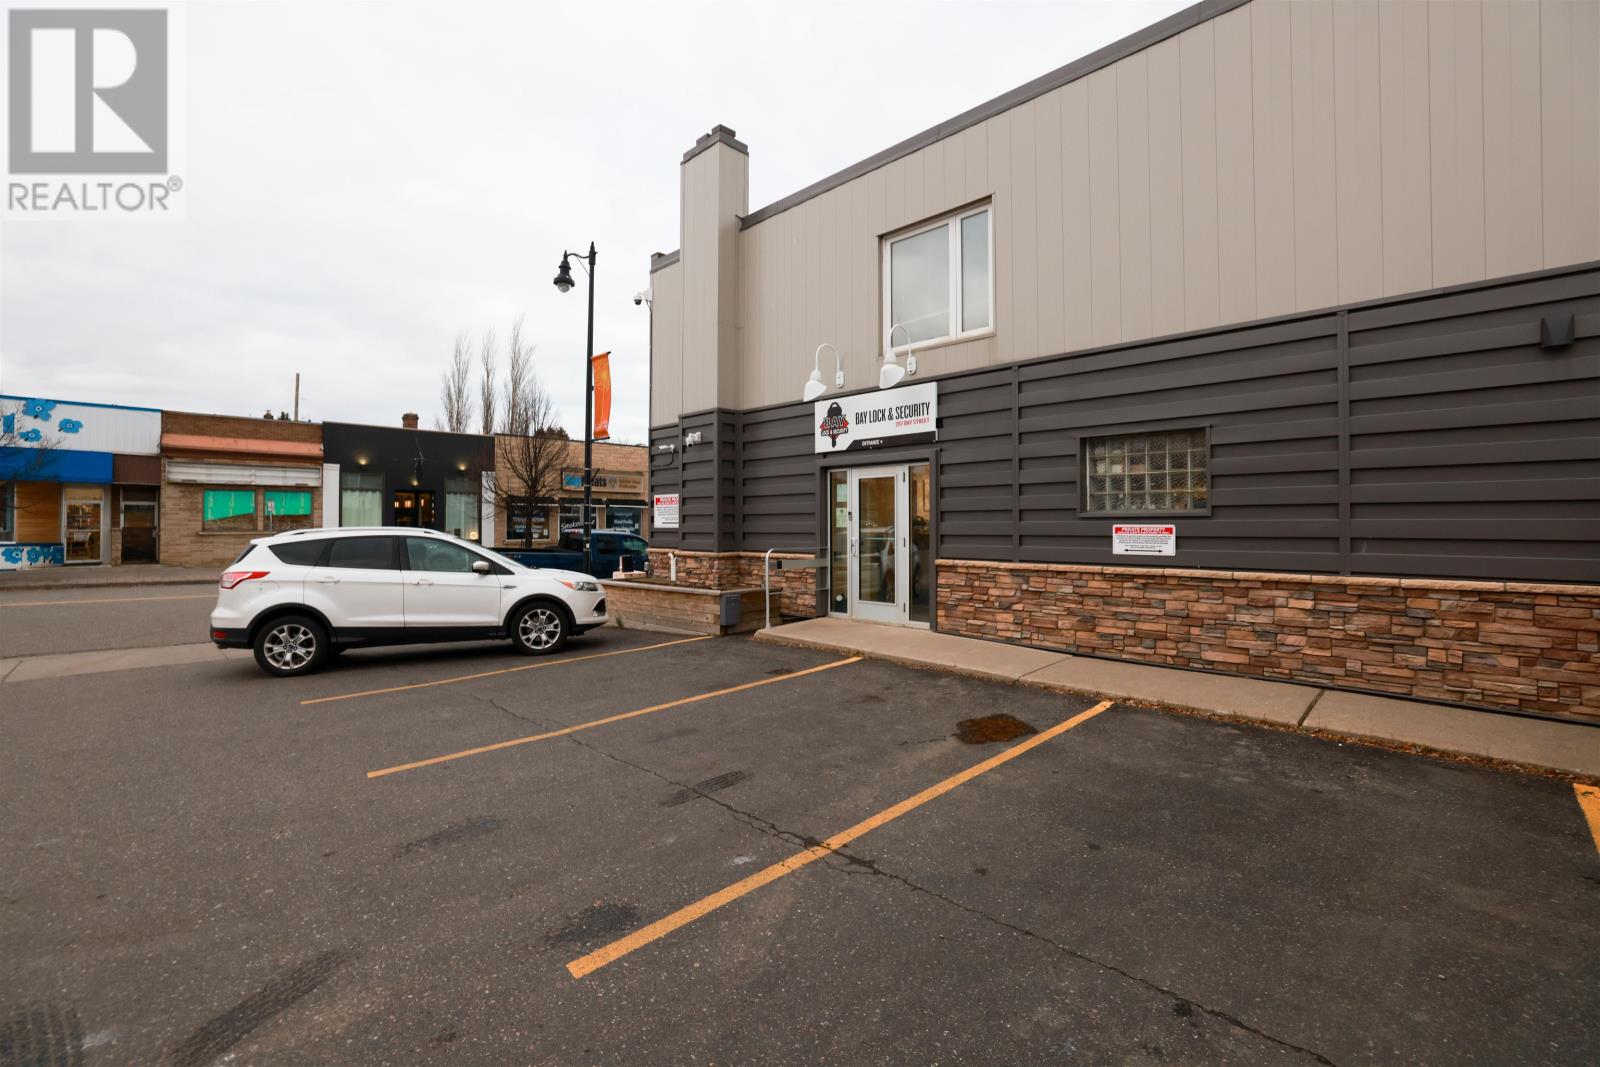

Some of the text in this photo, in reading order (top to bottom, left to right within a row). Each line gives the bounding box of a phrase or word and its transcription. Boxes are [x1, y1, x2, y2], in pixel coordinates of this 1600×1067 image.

[855, 402, 930, 425] BAY LOCK & SECURITY
[823, 415, 846, 429] BAY
[861, 439, 880, 447] ENTRANCE
